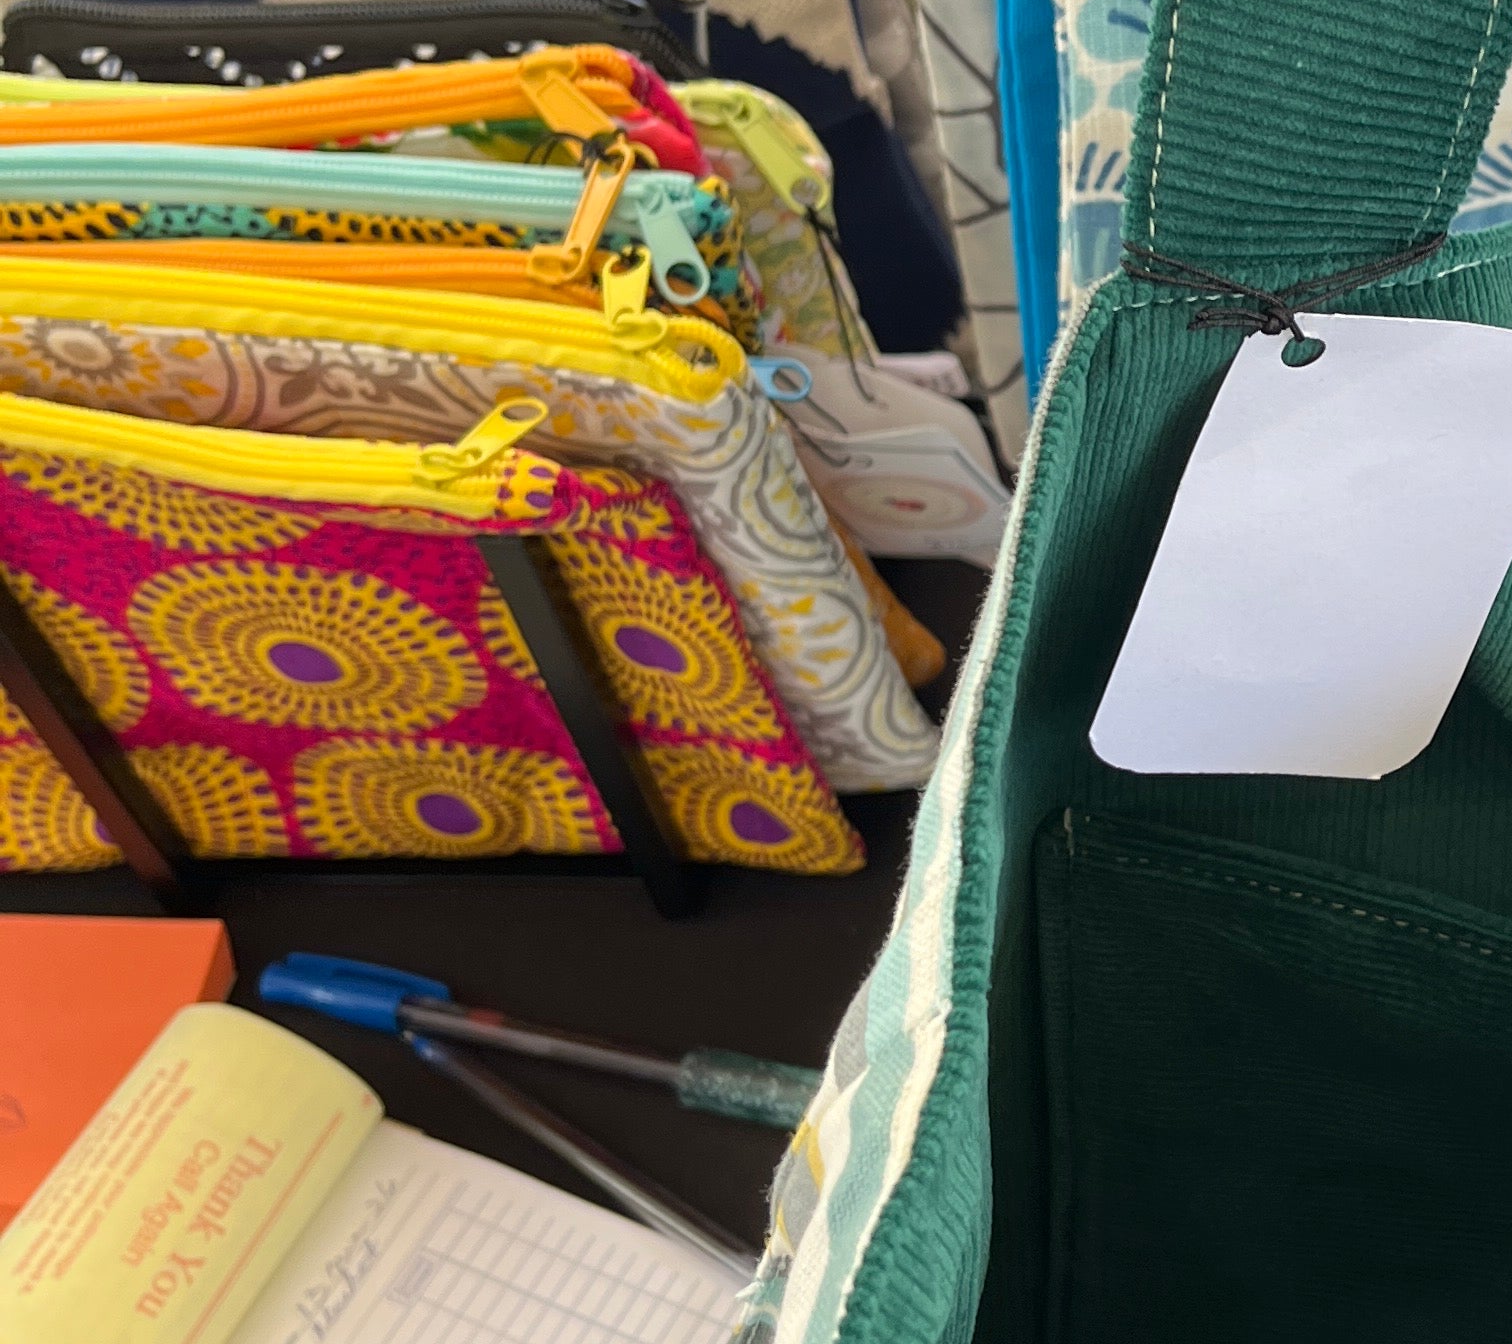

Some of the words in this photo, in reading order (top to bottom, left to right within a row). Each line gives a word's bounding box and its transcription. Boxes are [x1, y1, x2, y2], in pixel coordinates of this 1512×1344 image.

[174, 1139, 221, 1194] Call
[188, 1136, 283, 1243] Thank
[122, 1192, 183, 1267] Again
[135, 1253, 206, 1319] You
